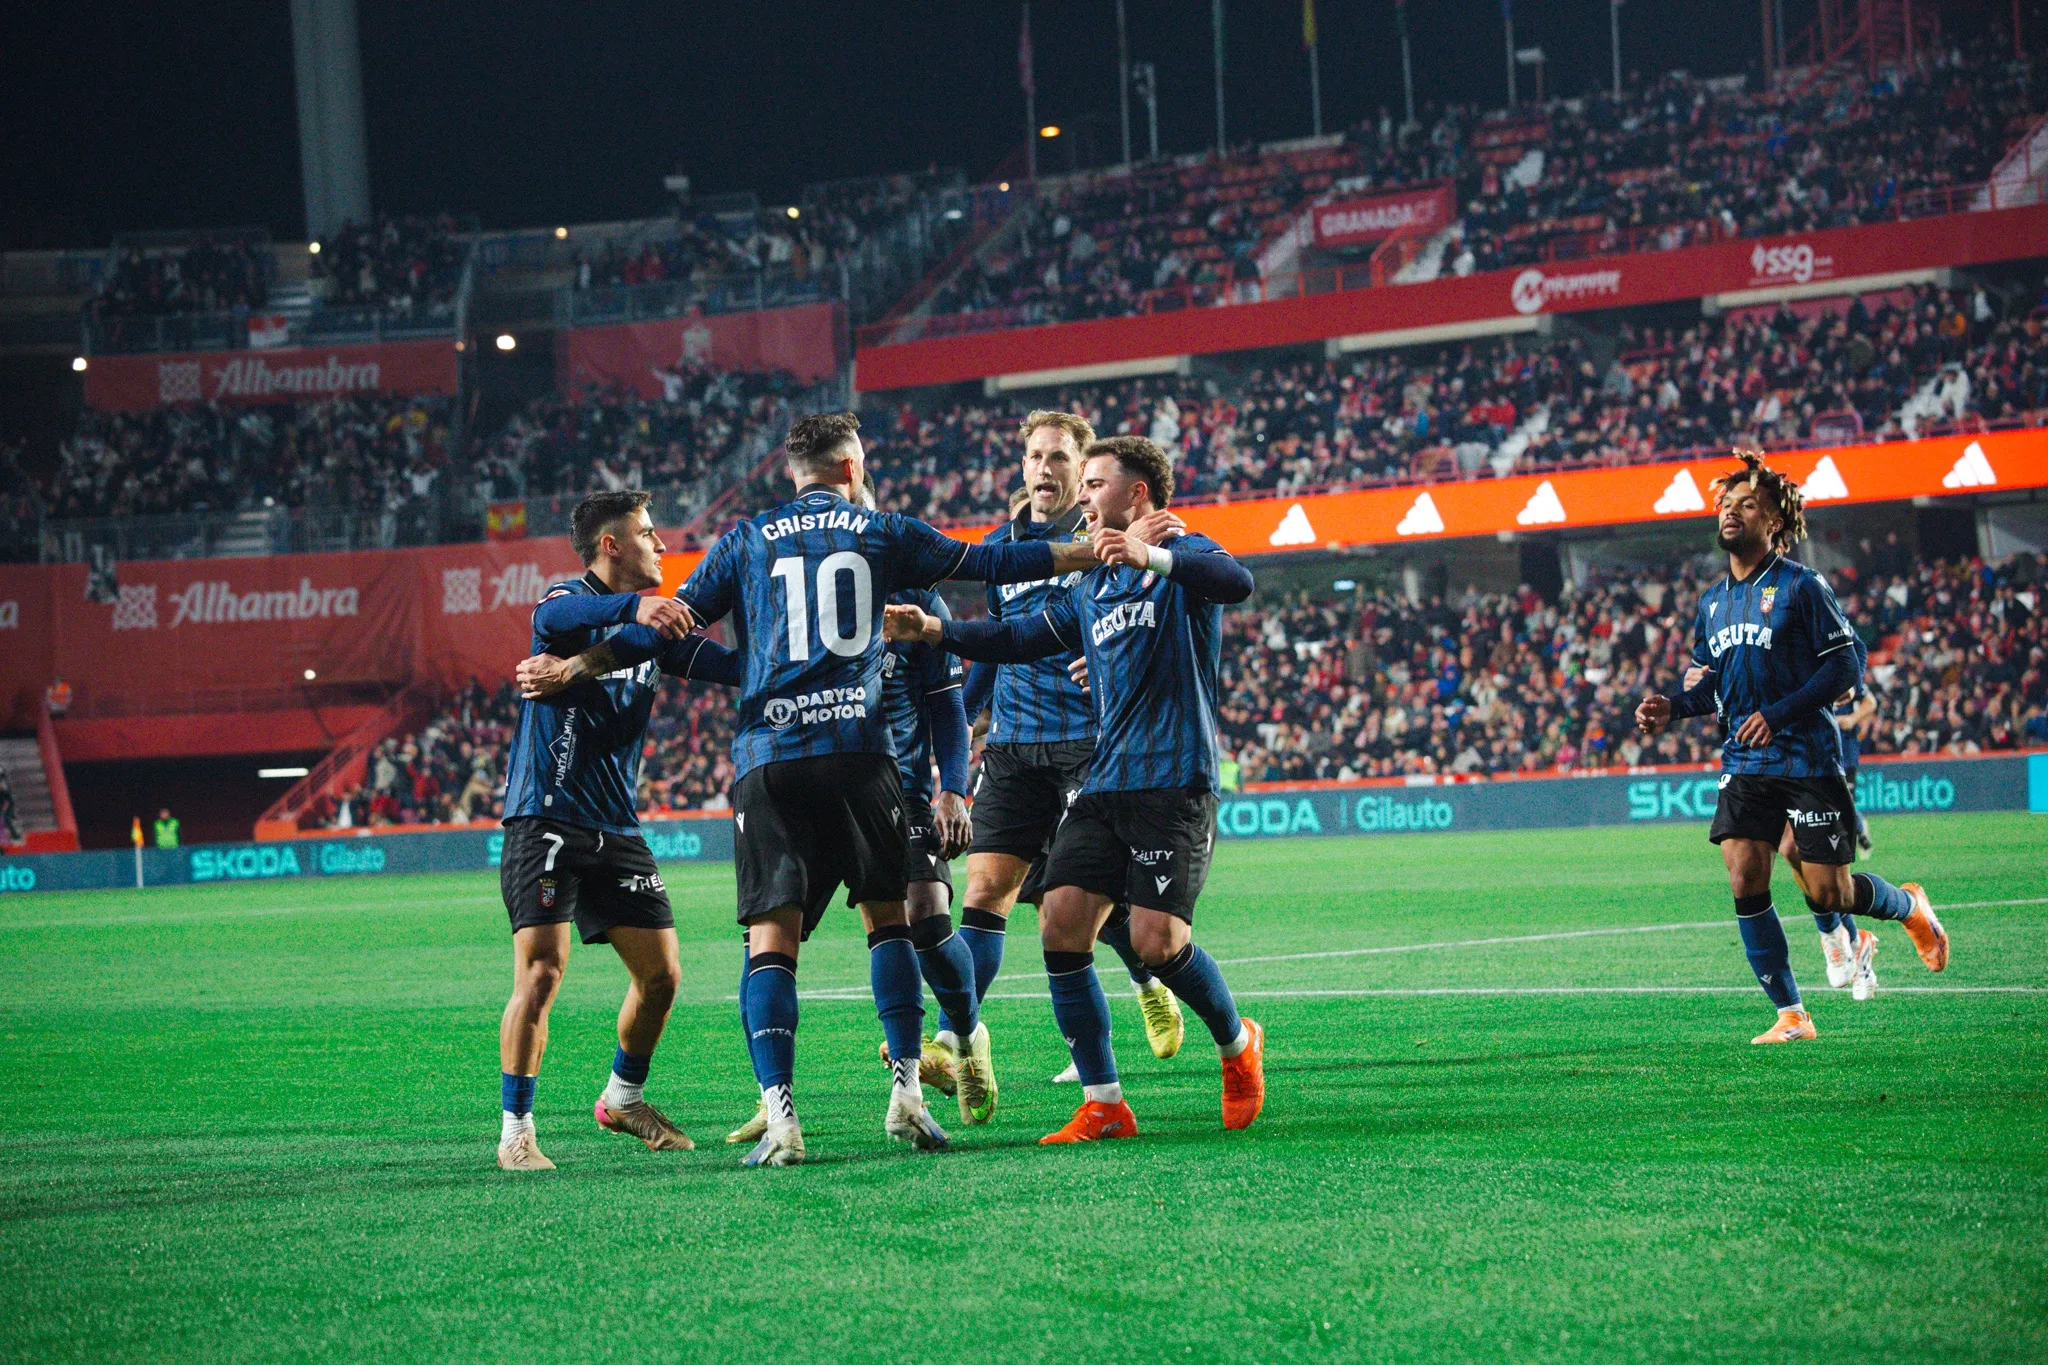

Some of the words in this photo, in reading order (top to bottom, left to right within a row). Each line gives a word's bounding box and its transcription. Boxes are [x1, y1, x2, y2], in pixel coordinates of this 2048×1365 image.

[211, 356, 380, 396] Alhambra
[761, 510, 870, 541] CRISTIAN
[168, 578, 360, 630] Alhambra
[770, 551, 873, 661] 10
[1091, 601, 1156, 647] CEUTA
[1708, 622, 1773, 658] CEUTA
[796, 686, 866, 709] DARYSO
[801, 704, 867, 725] MOTOR
[561, 707, 577, 748] ALMINA
[555, 751, 569, 787] PUNTA
[1217, 798, 1322, 836] ODA
[1355, 795, 1454, 831] Gilauto
[1628, 779, 1719, 819] SKO
[910, 826, 931, 835] ITY
[190, 846, 300, 881] SKODA
[542, 832, 565, 872] 7
[640, 873, 664, 891] HÉL
